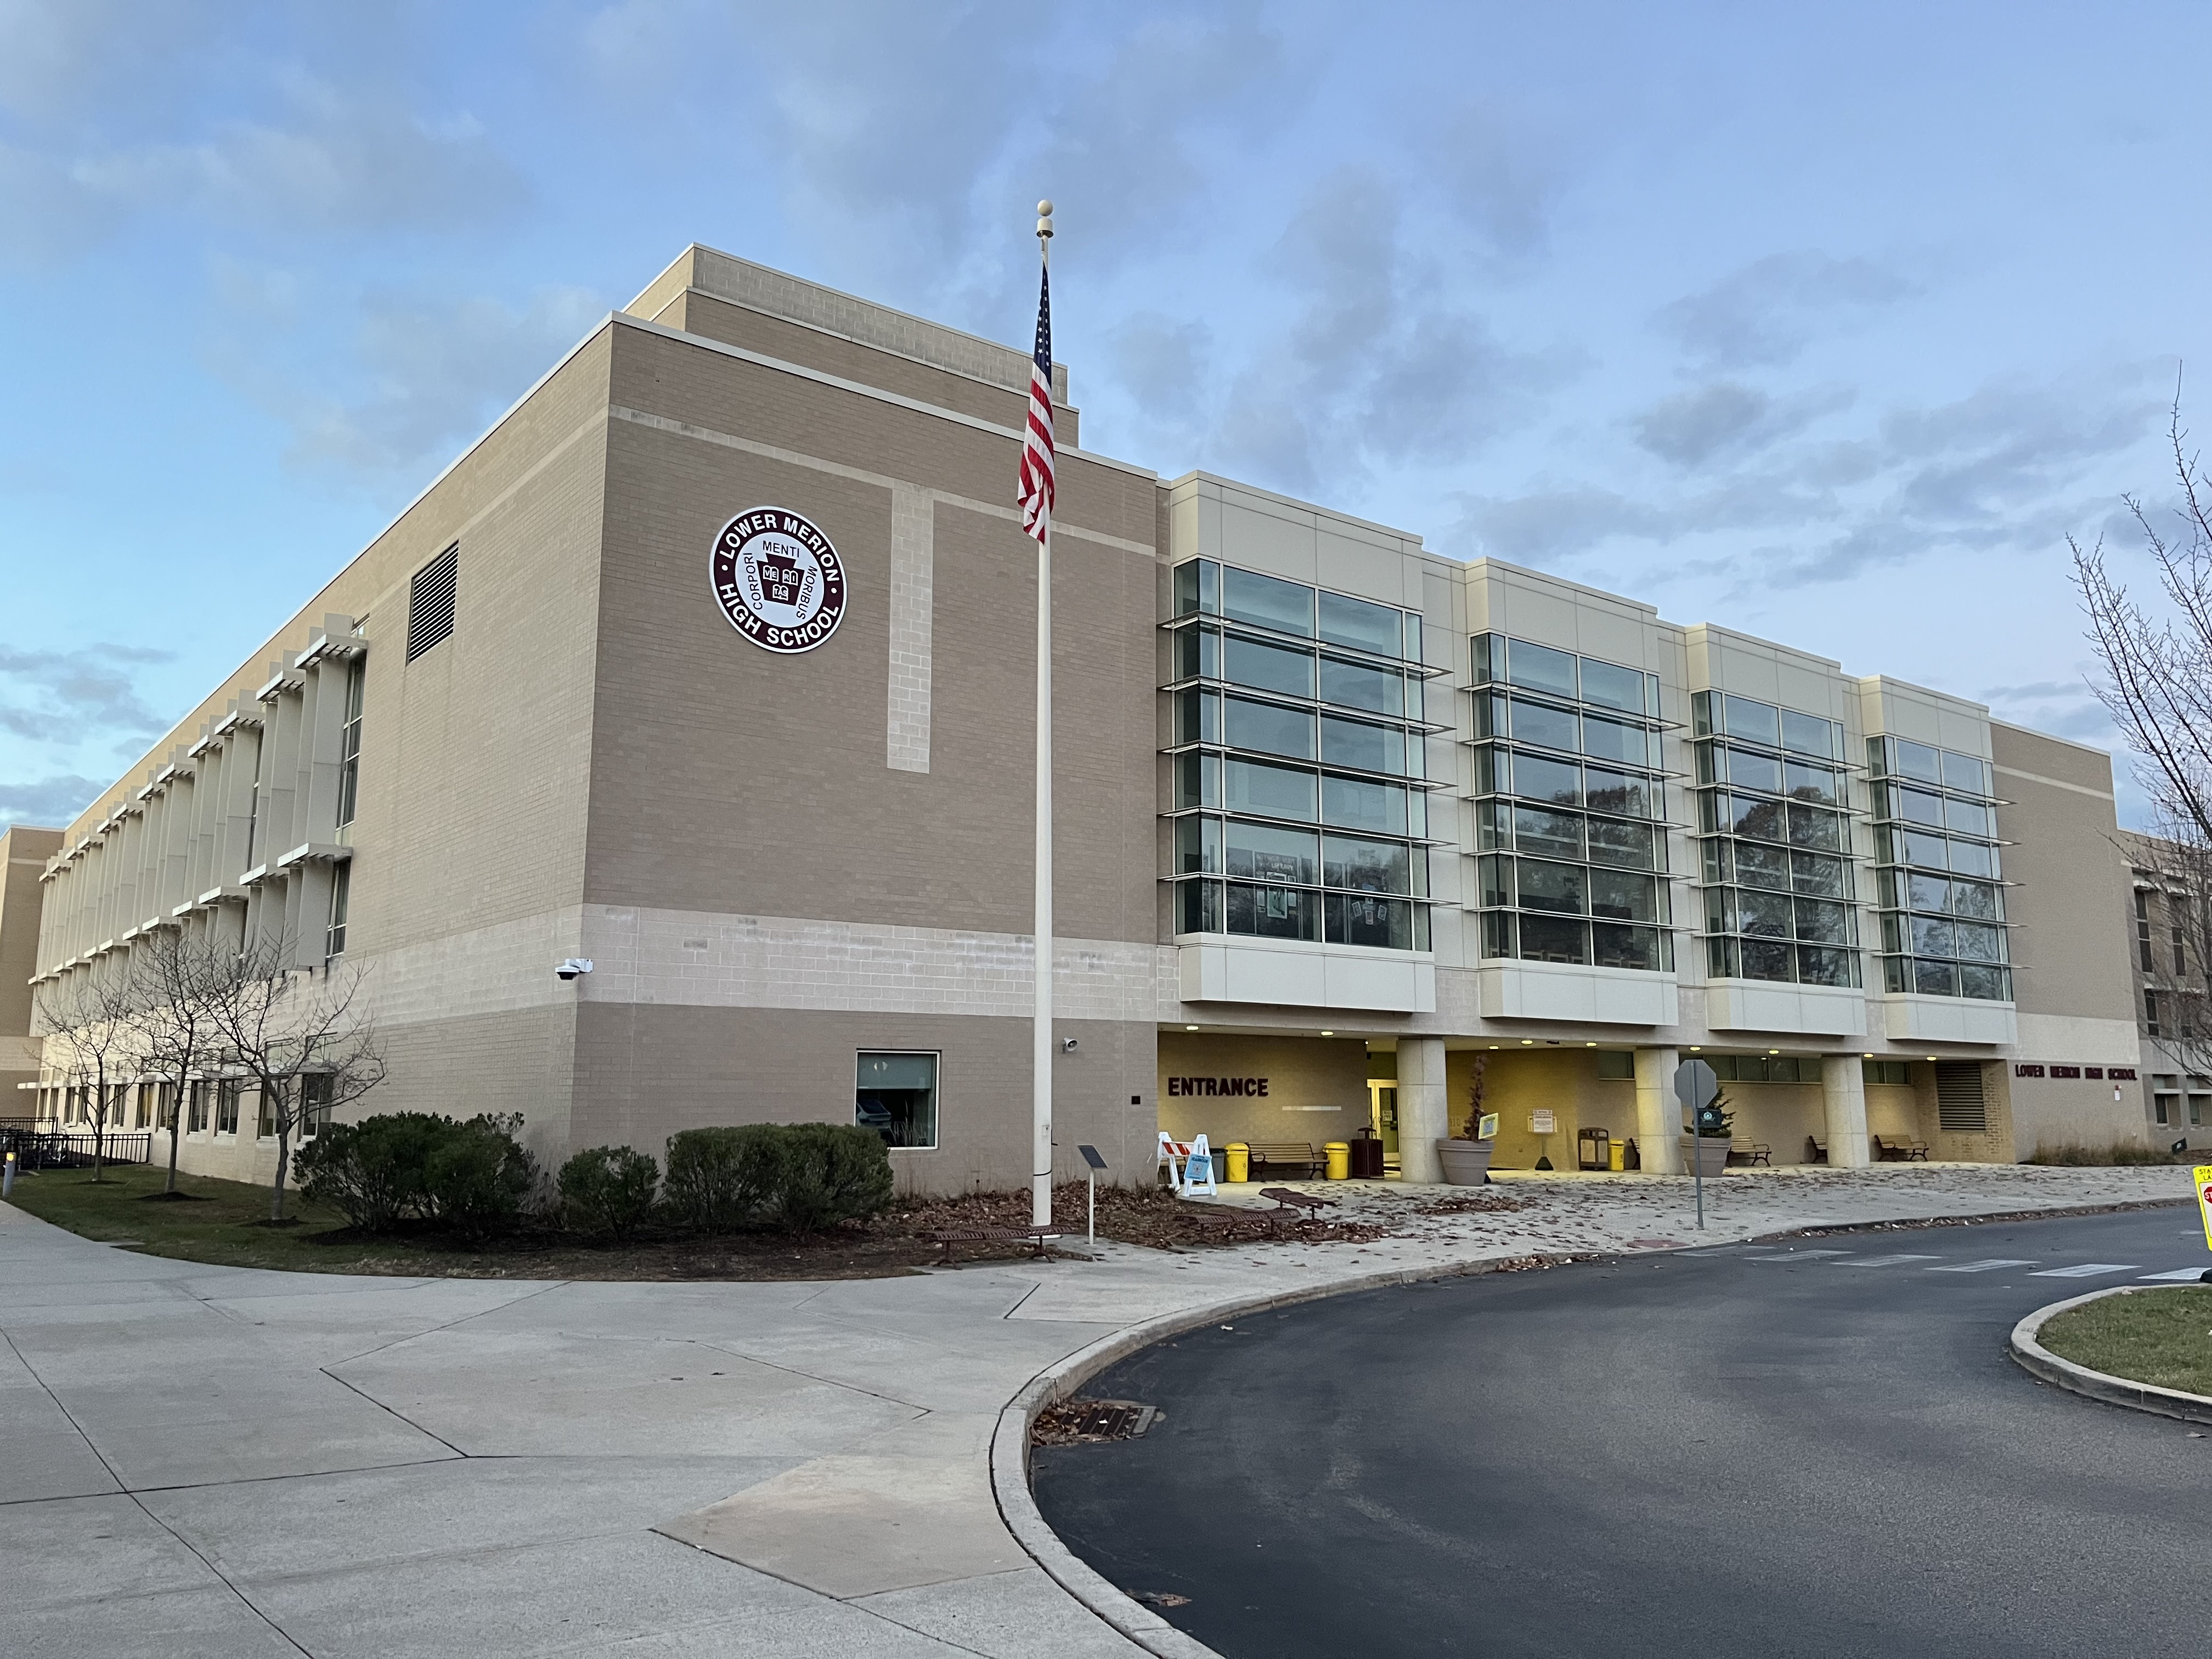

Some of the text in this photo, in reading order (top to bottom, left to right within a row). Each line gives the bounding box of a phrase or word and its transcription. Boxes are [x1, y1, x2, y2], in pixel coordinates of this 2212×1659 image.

[720, 514, 840, 582] LOWER MERION
[763, 540, 799, 558] MENTI
[743, 552, 763, 610] CORPORI
[796, 566, 817, 619] MORIBUS
[720, 584, 839, 646] HIGH SCHOOL
[1168, 1077, 1268, 1097] ENTRANCE
[2015, 1064, 2045, 1078] LOWER
